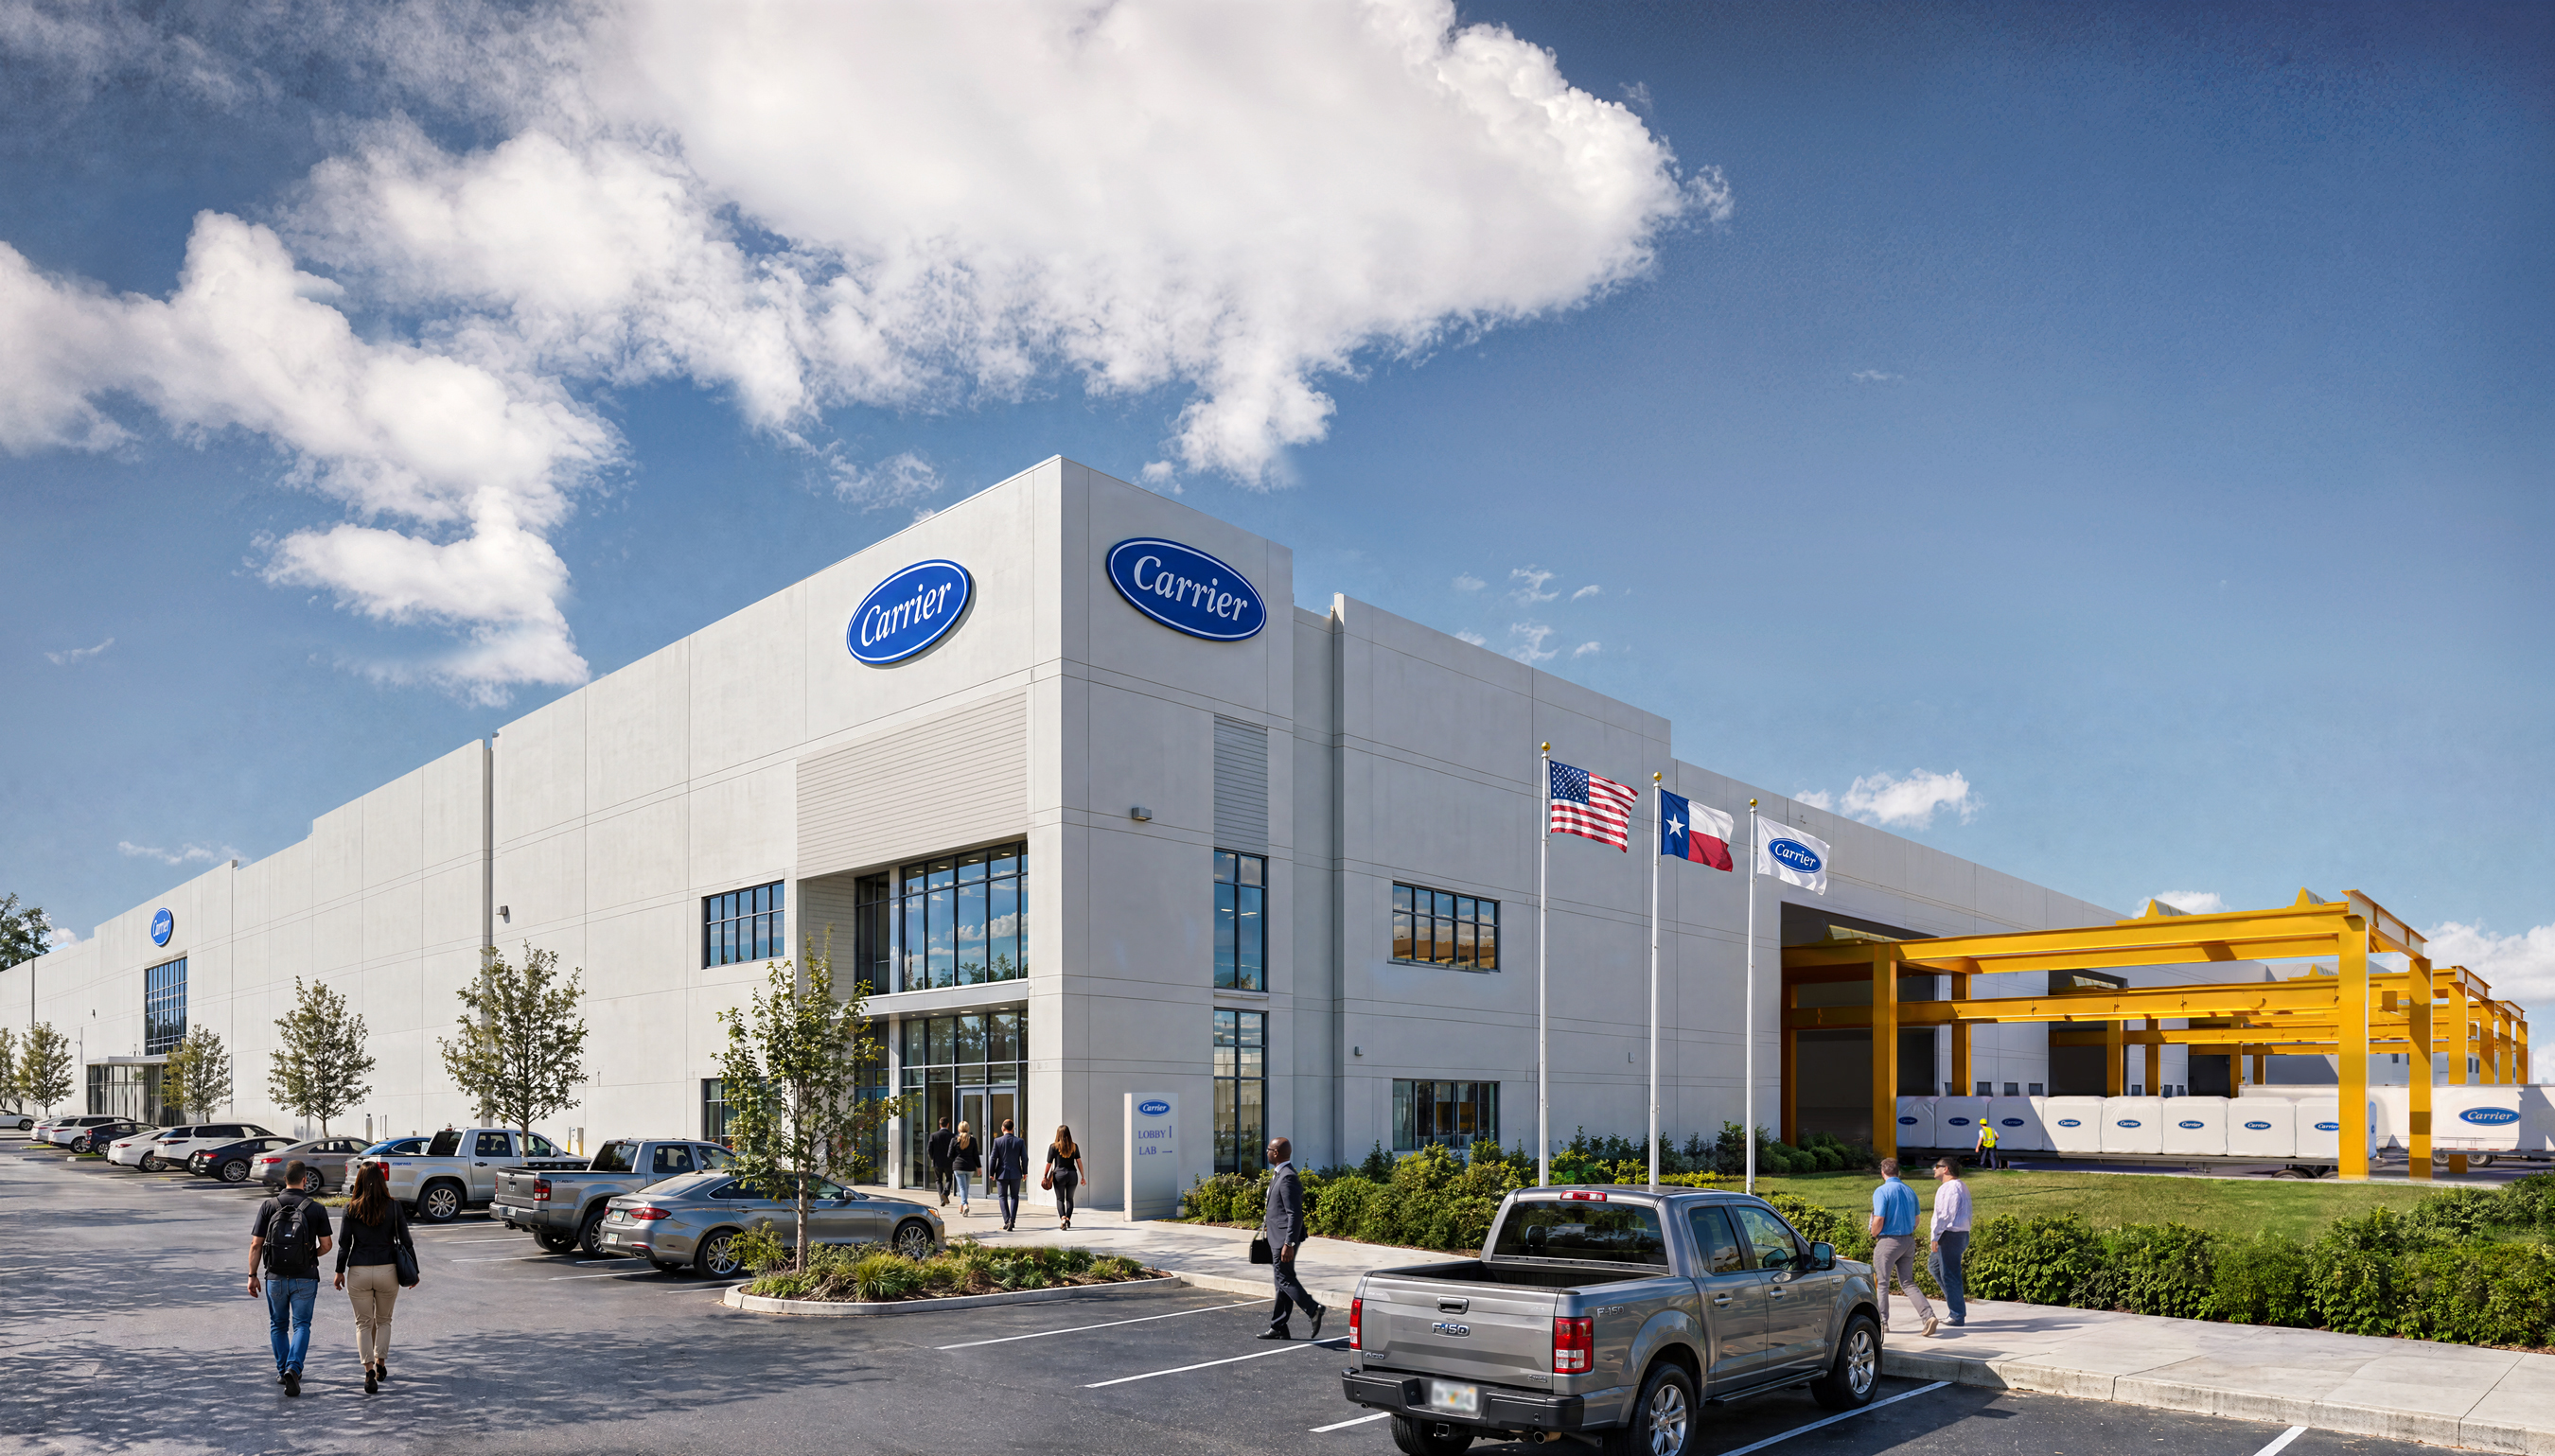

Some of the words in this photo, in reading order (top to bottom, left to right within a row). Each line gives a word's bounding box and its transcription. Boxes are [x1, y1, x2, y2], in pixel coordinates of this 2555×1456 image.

[1134, 555, 1248, 622] Carrier
[861, 582, 951, 647] Carrier
[1775, 843, 1816, 868] Carrier
[1142, 1103, 1167, 1112] Carrier
[2467, 1111, 2513, 1120] Carrier
[1138, 1130, 1166, 1139] LOBBY
[1138, 1146, 1156, 1155] LAB
[1596, 1307, 1625, 1318] F-150
[1432, 1323, 1470, 1336] F-150
